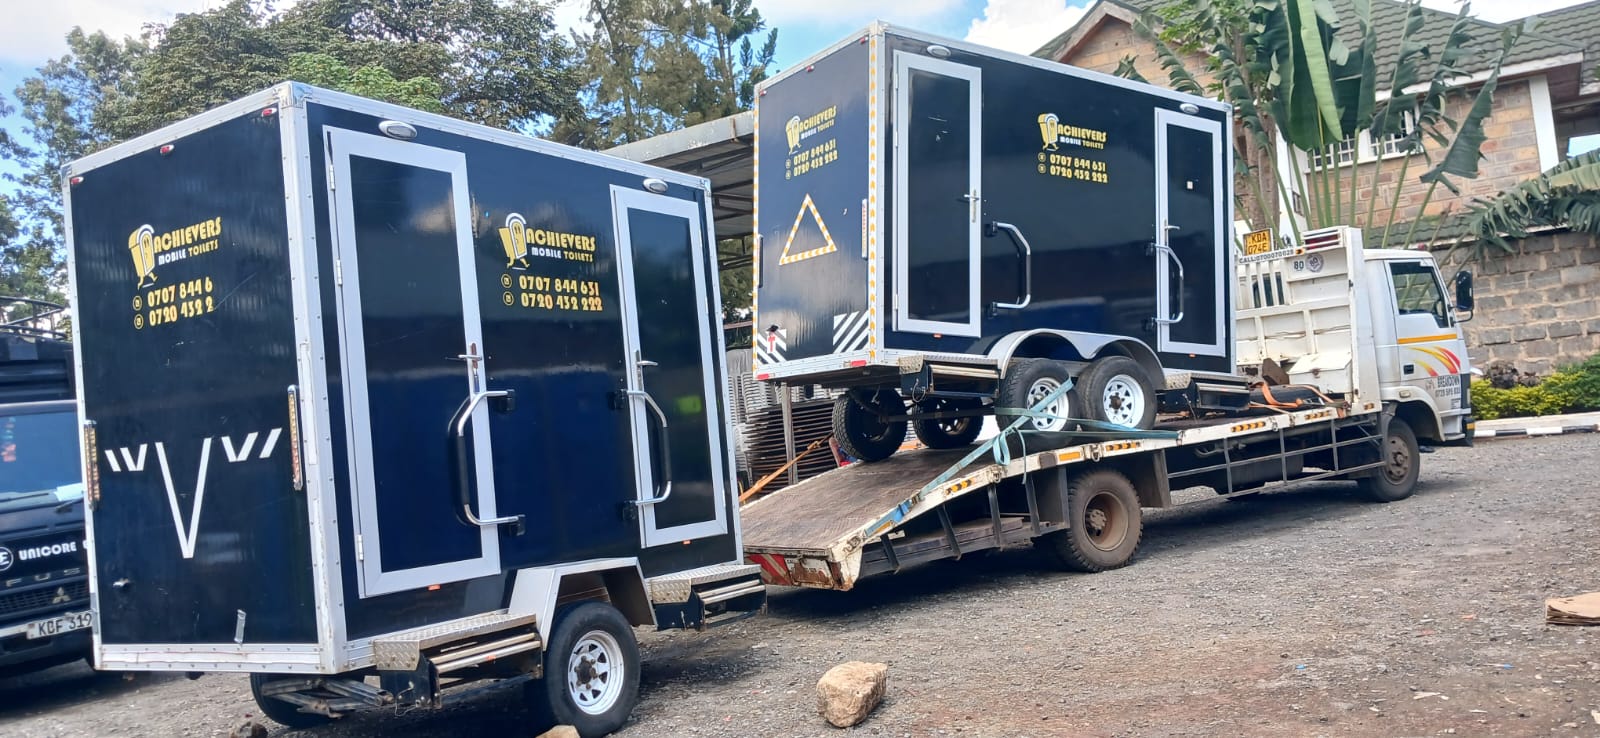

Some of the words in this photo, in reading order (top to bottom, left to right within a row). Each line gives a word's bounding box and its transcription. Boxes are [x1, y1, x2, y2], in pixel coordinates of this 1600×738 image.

[1057, 124, 1107, 142] ACHIEVERS
[1060, 136, 1081, 145] MOBILE
[1083, 141, 1104, 149] TOILETS
[1049, 154, 1072, 167] 0707
[1073, 158, 1091, 170] 844
[1092, 160, 1106, 172] 631
[1049, 165, 1073, 179] 0720
[1073, 169, 1091, 181] 432
[1091, 171, 1108, 184] 222
[153, 216, 222, 254] ACHIEVERS
[525, 227, 596, 252] ACHIEVERS
[1251, 233, 1267, 243] KDA
[158, 248, 187, 266] MOBILE
[187, 239, 219, 257] TOILETS
[531, 246, 562, 259] MOBILE
[563, 251, 593, 263] TOILETS
[1294, 261, 1304, 270] 80
[147, 285, 176, 307] 0707
[179, 278, 203, 299] 844
[519, 275, 551, 291] 0707
[554, 278, 578, 294] 844
[580, 281, 600, 296] 631
[149, 305, 178, 326] 0720
[180, 298, 204, 318] 432
[520, 292, 553, 310] 0720
[556, 295, 579, 311] 432
[581, 296, 604, 312] 222
[18, 541, 77, 561] UNICORE
[5, 567, 81, 588] FUS
[69, 612, 93, 630] 319
